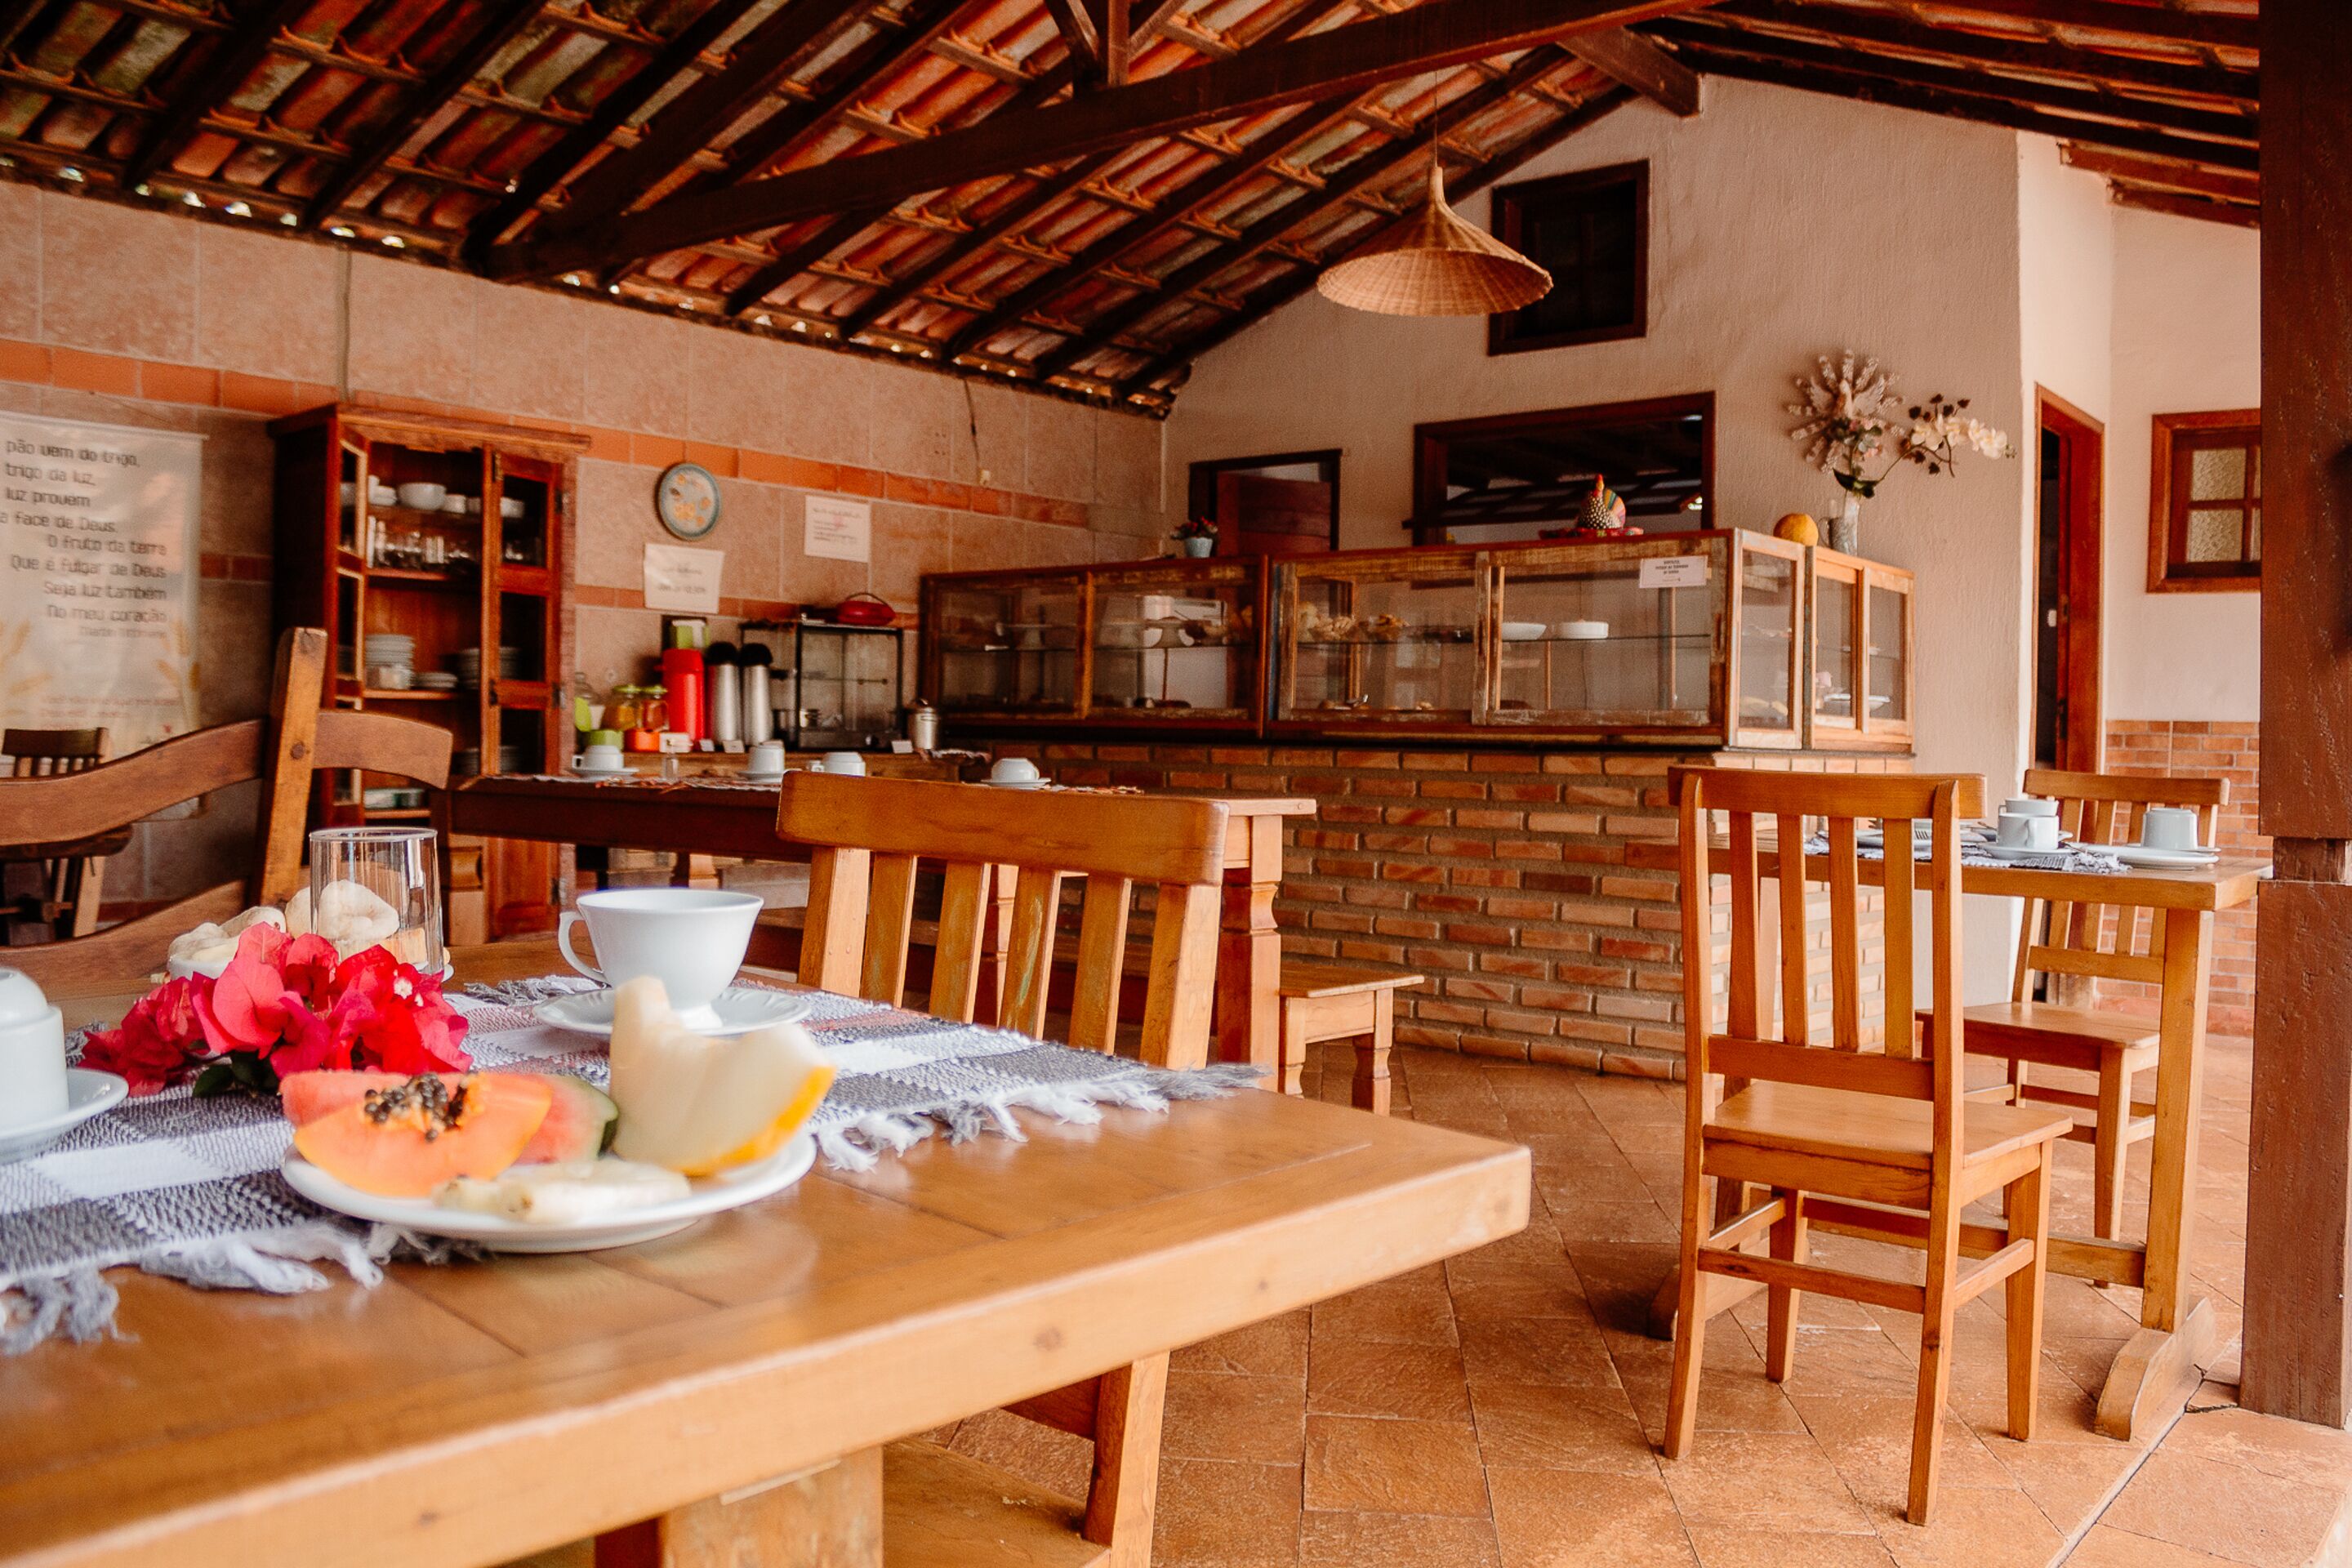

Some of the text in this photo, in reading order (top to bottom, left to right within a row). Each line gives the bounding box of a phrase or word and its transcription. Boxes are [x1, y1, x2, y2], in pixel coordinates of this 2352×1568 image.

[49, 469, 67, 482] da
[6, 486, 28, 501] luz
[56, 515, 74, 529] de
[107, 540, 125, 553] da
[131, 541, 167, 556] terra
[11, 555, 39, 571] Que
[110, 563, 128, 577] de
[132, 562, 167, 579] Deus
[44, 581, 76, 597] Seja
[82, 583, 102, 598] luz
